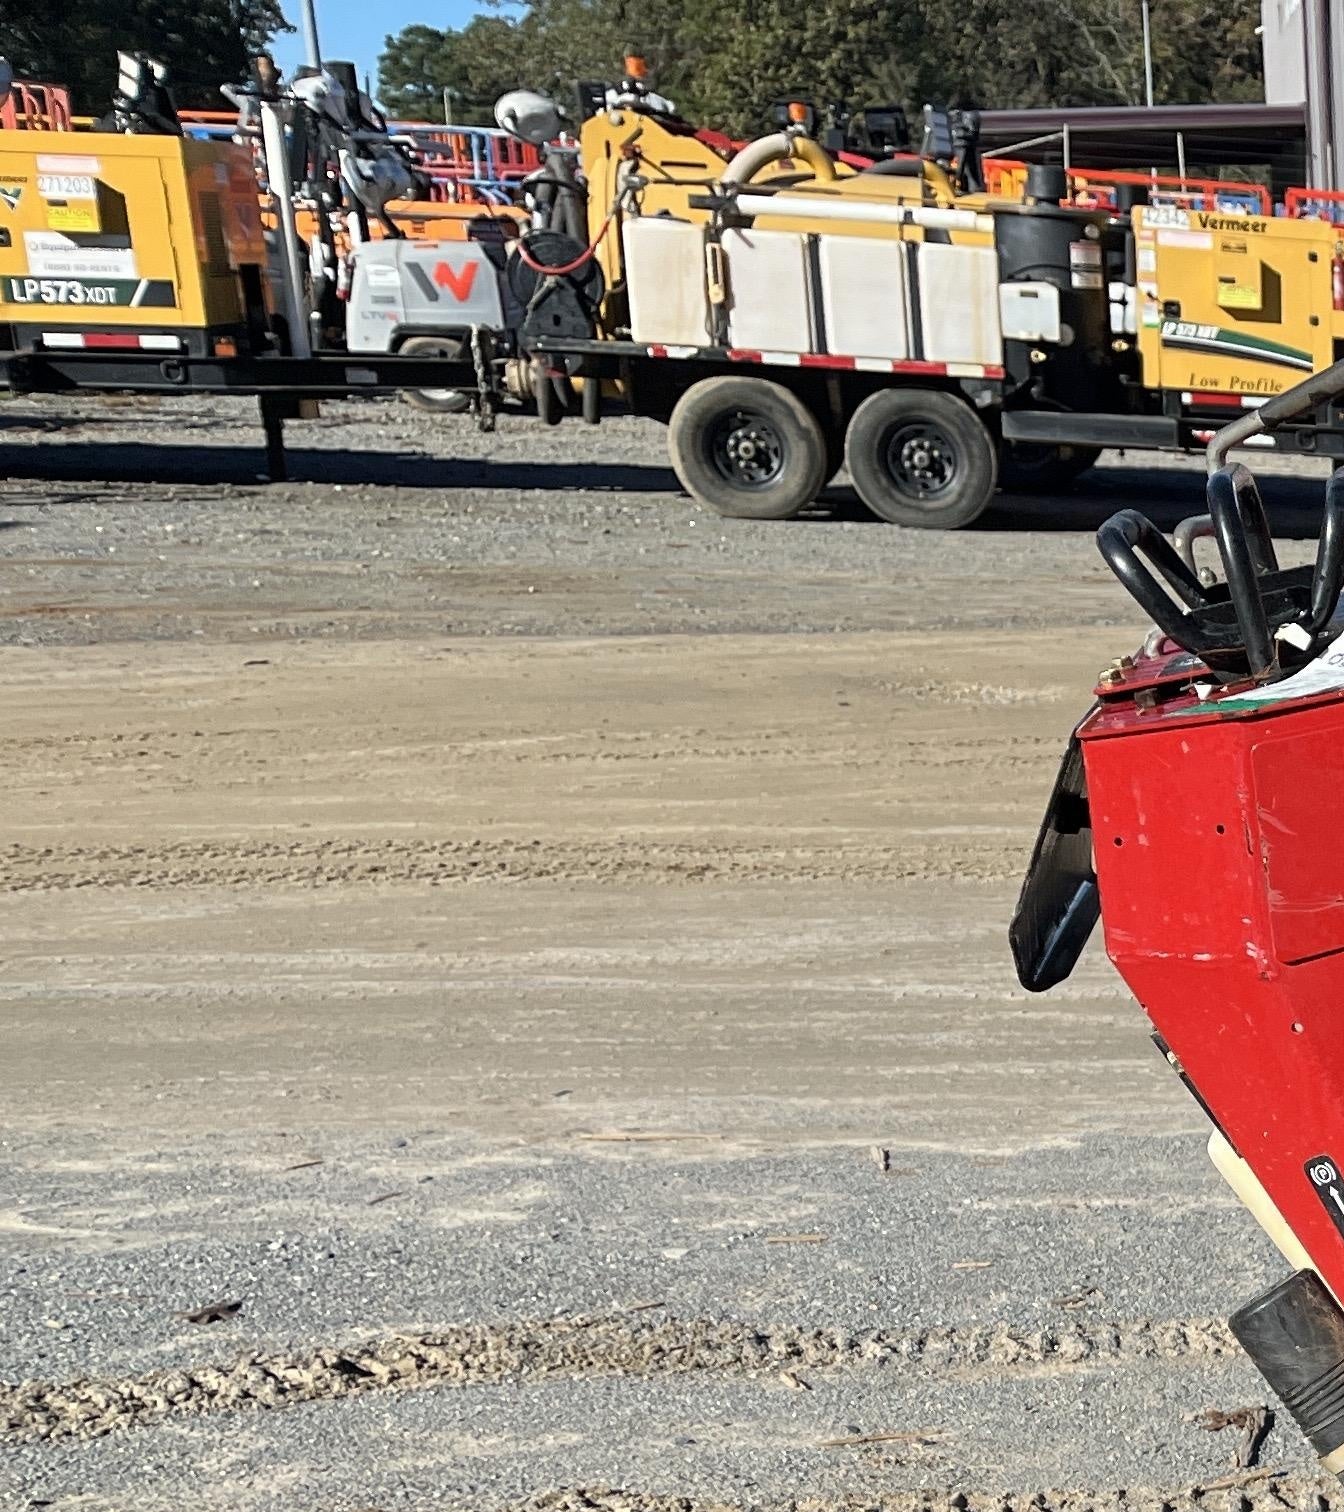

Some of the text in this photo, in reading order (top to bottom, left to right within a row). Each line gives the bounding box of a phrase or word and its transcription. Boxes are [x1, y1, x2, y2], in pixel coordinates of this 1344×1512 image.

[1199, 213, 1267, 233] Vermeer
[1189, 372, 1283, 393] Low Profile
